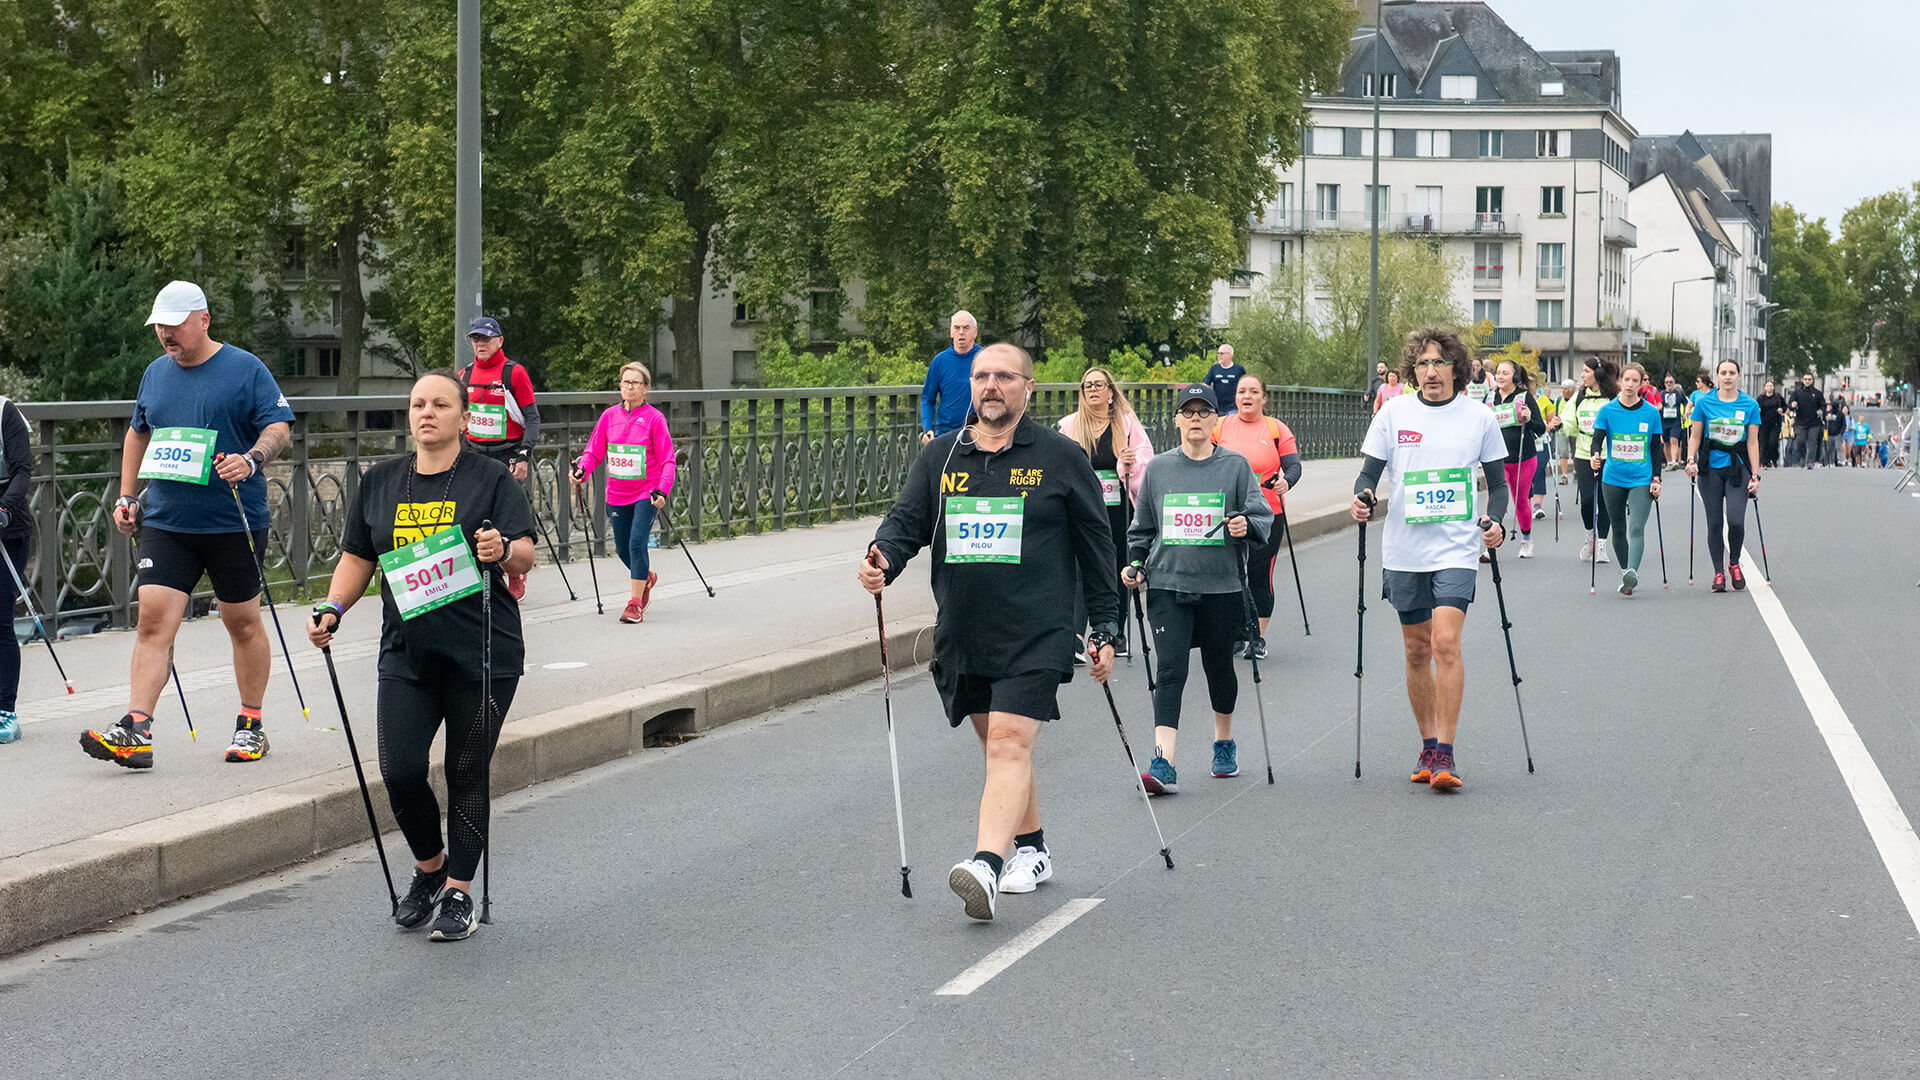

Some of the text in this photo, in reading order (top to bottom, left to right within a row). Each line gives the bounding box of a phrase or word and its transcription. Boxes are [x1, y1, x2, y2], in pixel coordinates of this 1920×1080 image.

[471, 416, 494, 427] 5383
[1400, 434, 1421, 443] SNCF
[1715, 427, 1737, 436] 5124
[153, 447, 192, 462] 5305
[1616, 444, 1639, 453] 5123
[610, 457, 633, 468] 5384
[1010, 468, 1043, 477] WE ARE
[942, 472, 970, 493] NZ
[1009, 476, 1041, 487] RUGBY
[1416, 489, 1455, 504] 5192
[397, 506, 454, 521] COLOR
[1174, 513, 1212, 527] 5081
[959, 522, 1008, 539] 5197
[405, 557, 454, 592] 5017
[424, 581, 450, 597] EMILIE
